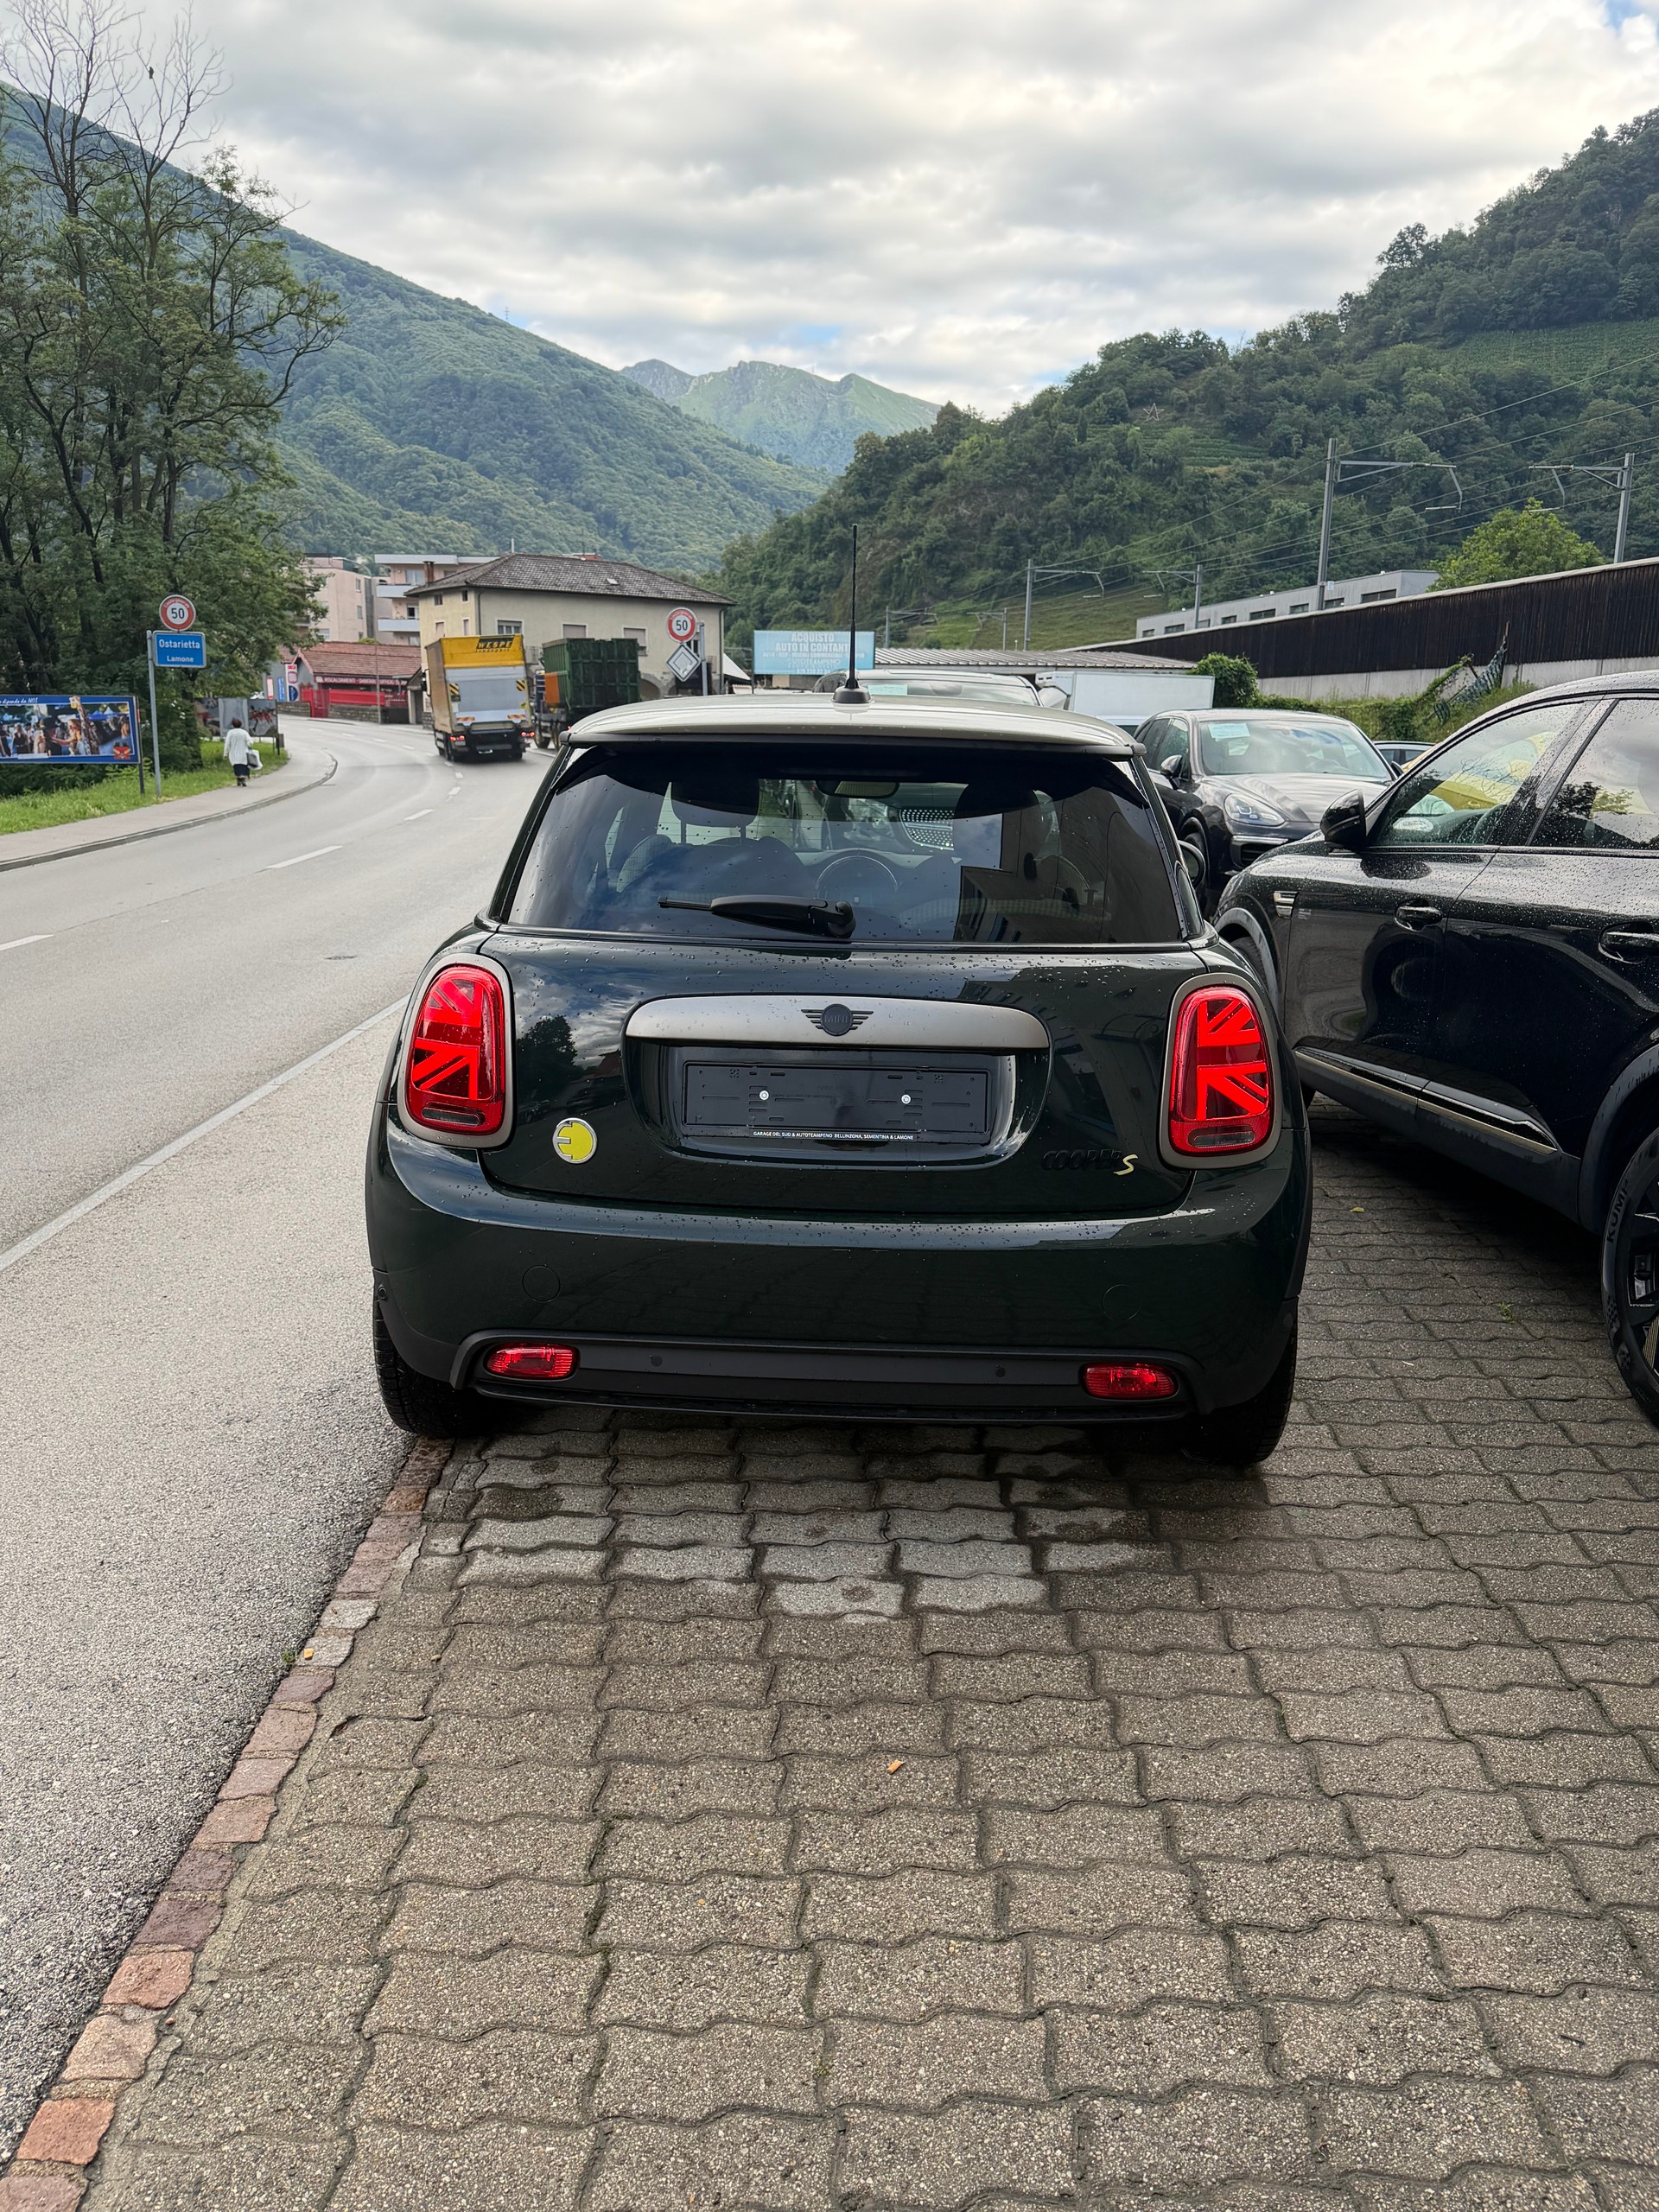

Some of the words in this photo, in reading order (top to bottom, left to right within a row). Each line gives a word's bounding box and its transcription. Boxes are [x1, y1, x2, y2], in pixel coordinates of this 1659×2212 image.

[171, 607, 185, 620] 50
[676, 620, 688, 631] 50
[791, 633, 834, 642] ACQUISTO
[159, 639, 200, 649] Ostarietta
[478, 640, 512, 649] WESPE
[775, 643, 798, 652] AUTO
[799, 643, 809, 652] IN
[810, 643, 850, 652] CONTANT
[824, 1014, 849, 1024] MINI
[1042, 1149, 1122, 1170] COOPER
[1114, 1154, 1138, 1176] S
